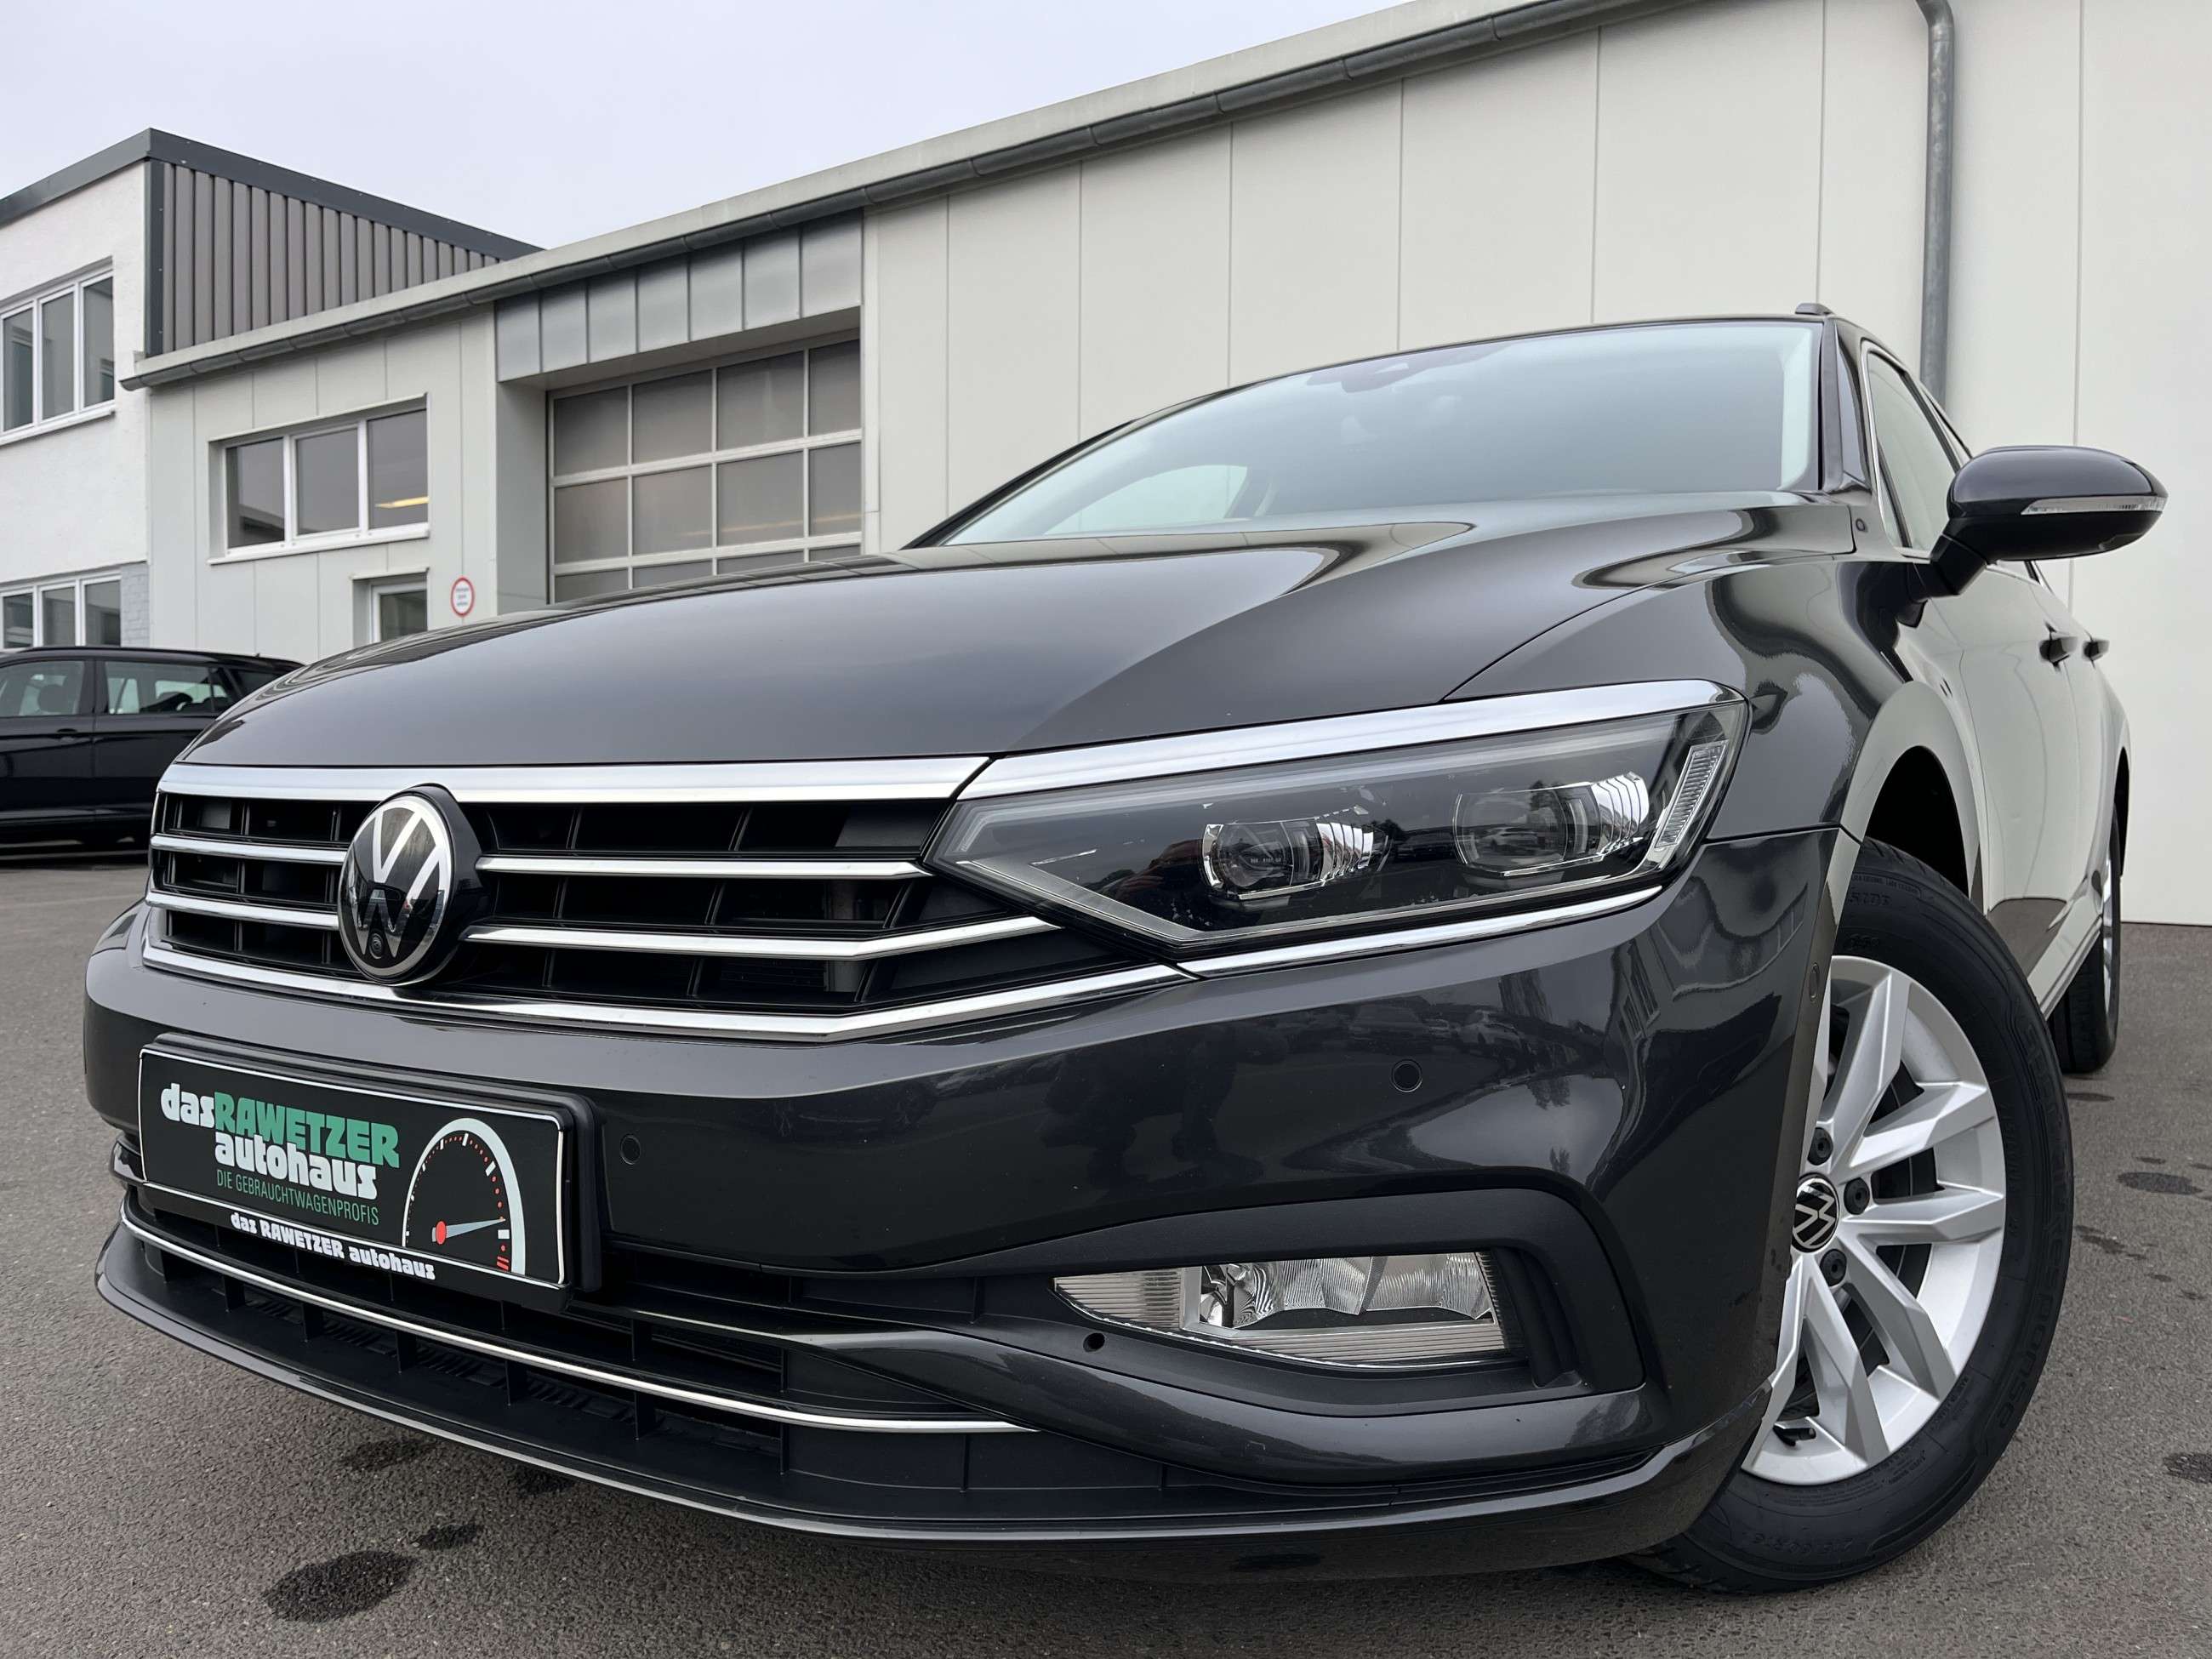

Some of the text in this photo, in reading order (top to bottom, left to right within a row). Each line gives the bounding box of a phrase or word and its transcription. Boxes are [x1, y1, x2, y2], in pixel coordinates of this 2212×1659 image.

[214, 1131, 378, 1200] autohaus
[216, 1169, 379, 1226] DIE GEBRAUCHTWAGENPROFIS
[230, 1211, 436, 1280] das RAWETZER autohaus
